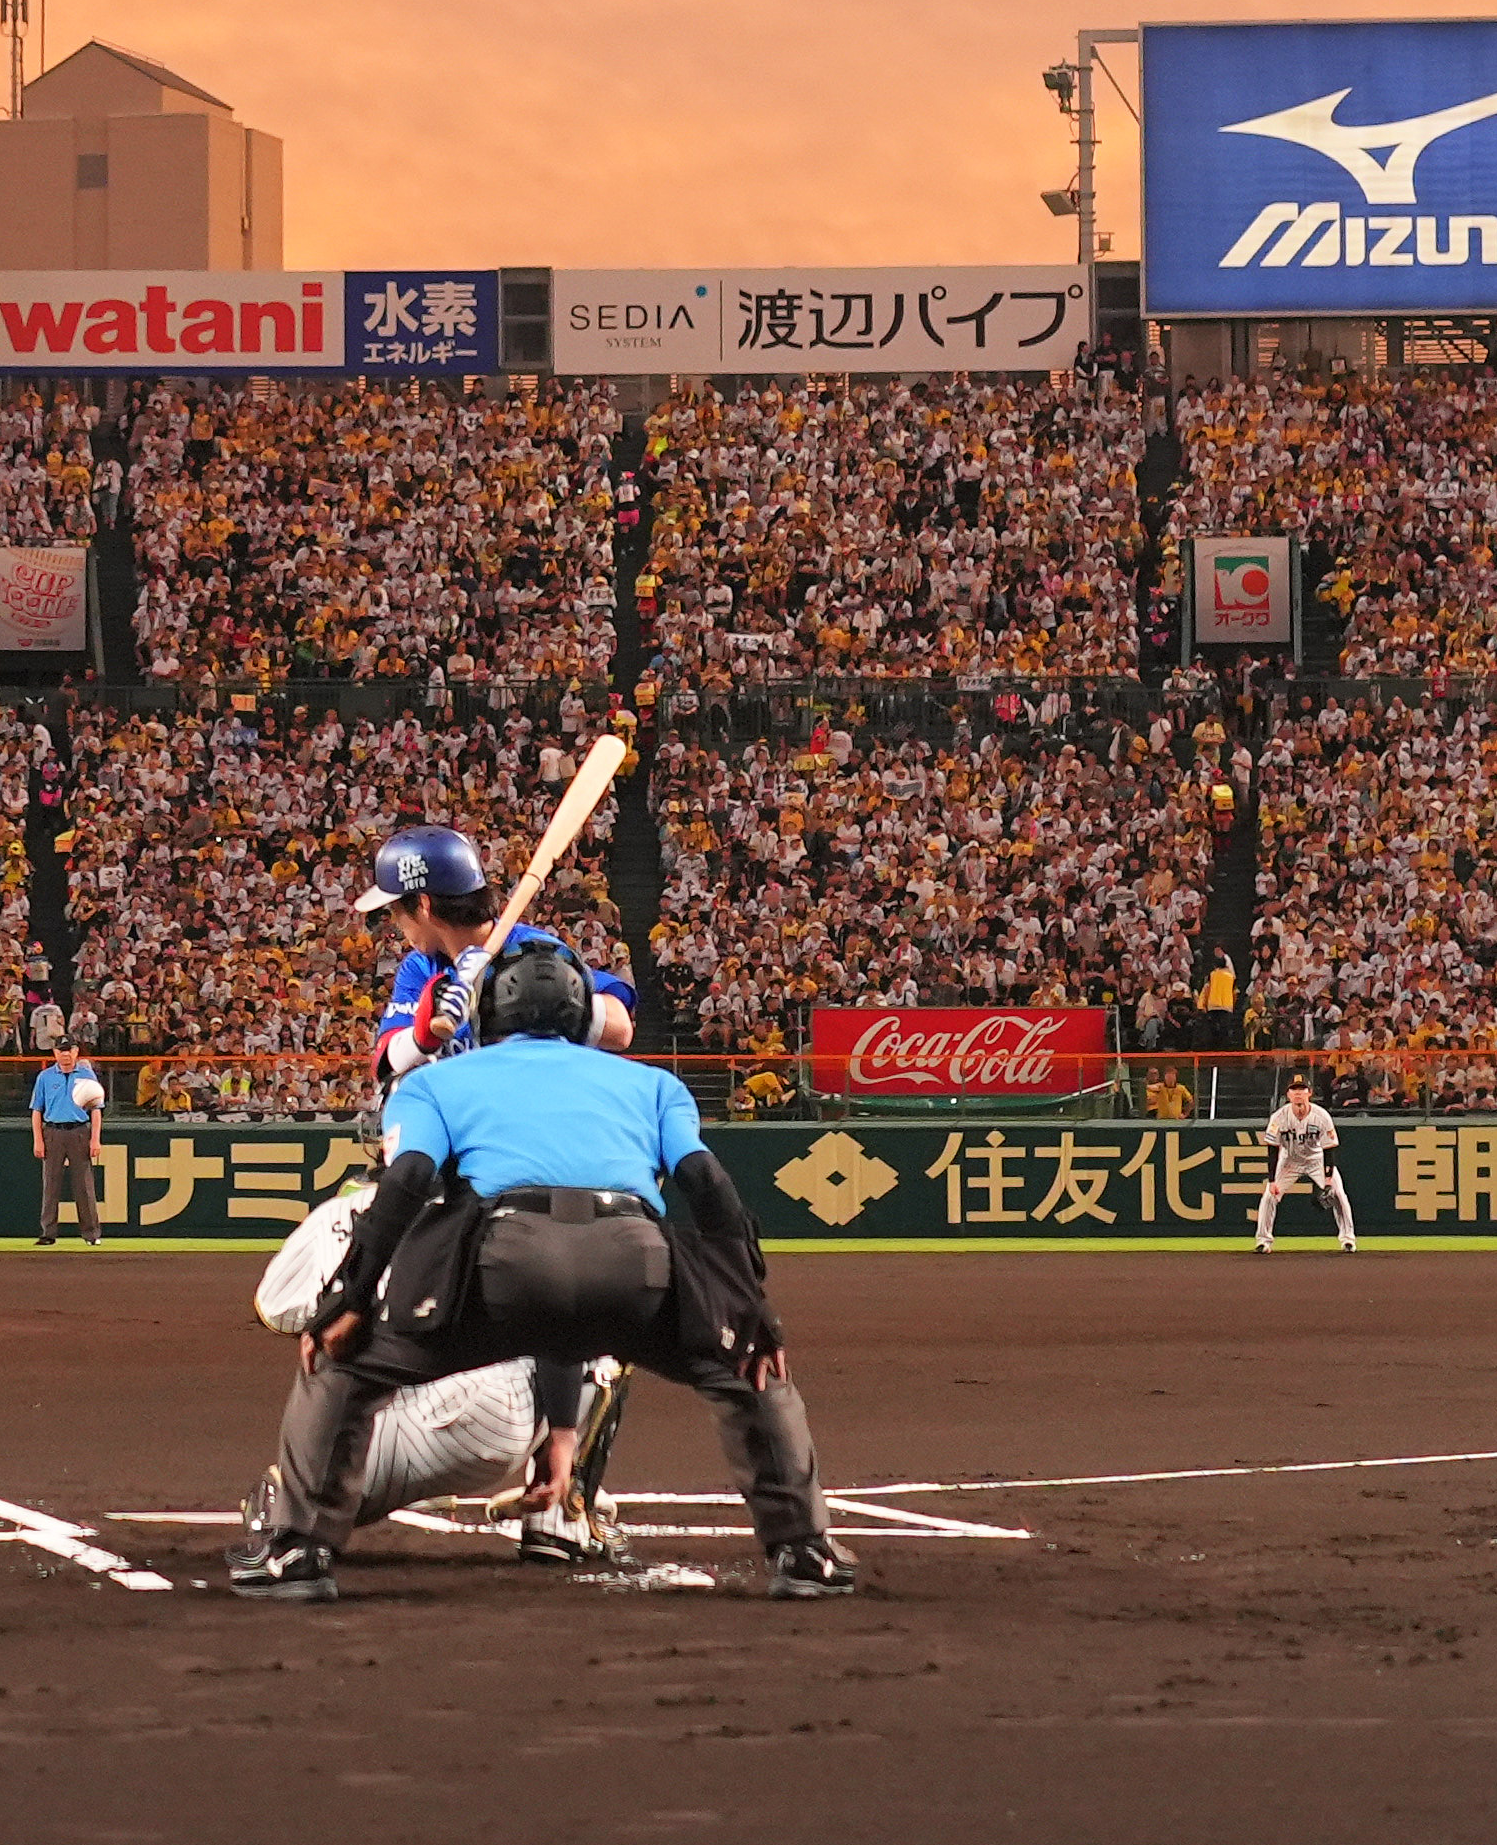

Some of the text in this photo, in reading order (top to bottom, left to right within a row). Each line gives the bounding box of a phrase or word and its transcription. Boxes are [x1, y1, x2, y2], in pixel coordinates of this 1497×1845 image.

[363, 281, 477, 337] 水素
[569, 304, 695, 330] SEDIA
[737, 283, 1085, 350] 渡辺パイプ
[362, 340, 478, 365] エネルギー
[605, 337, 662, 348] SYSTEM
[1214, 612, 1271, 628] オークワ
[849, 1014, 1067, 1086] Coca-Cola
